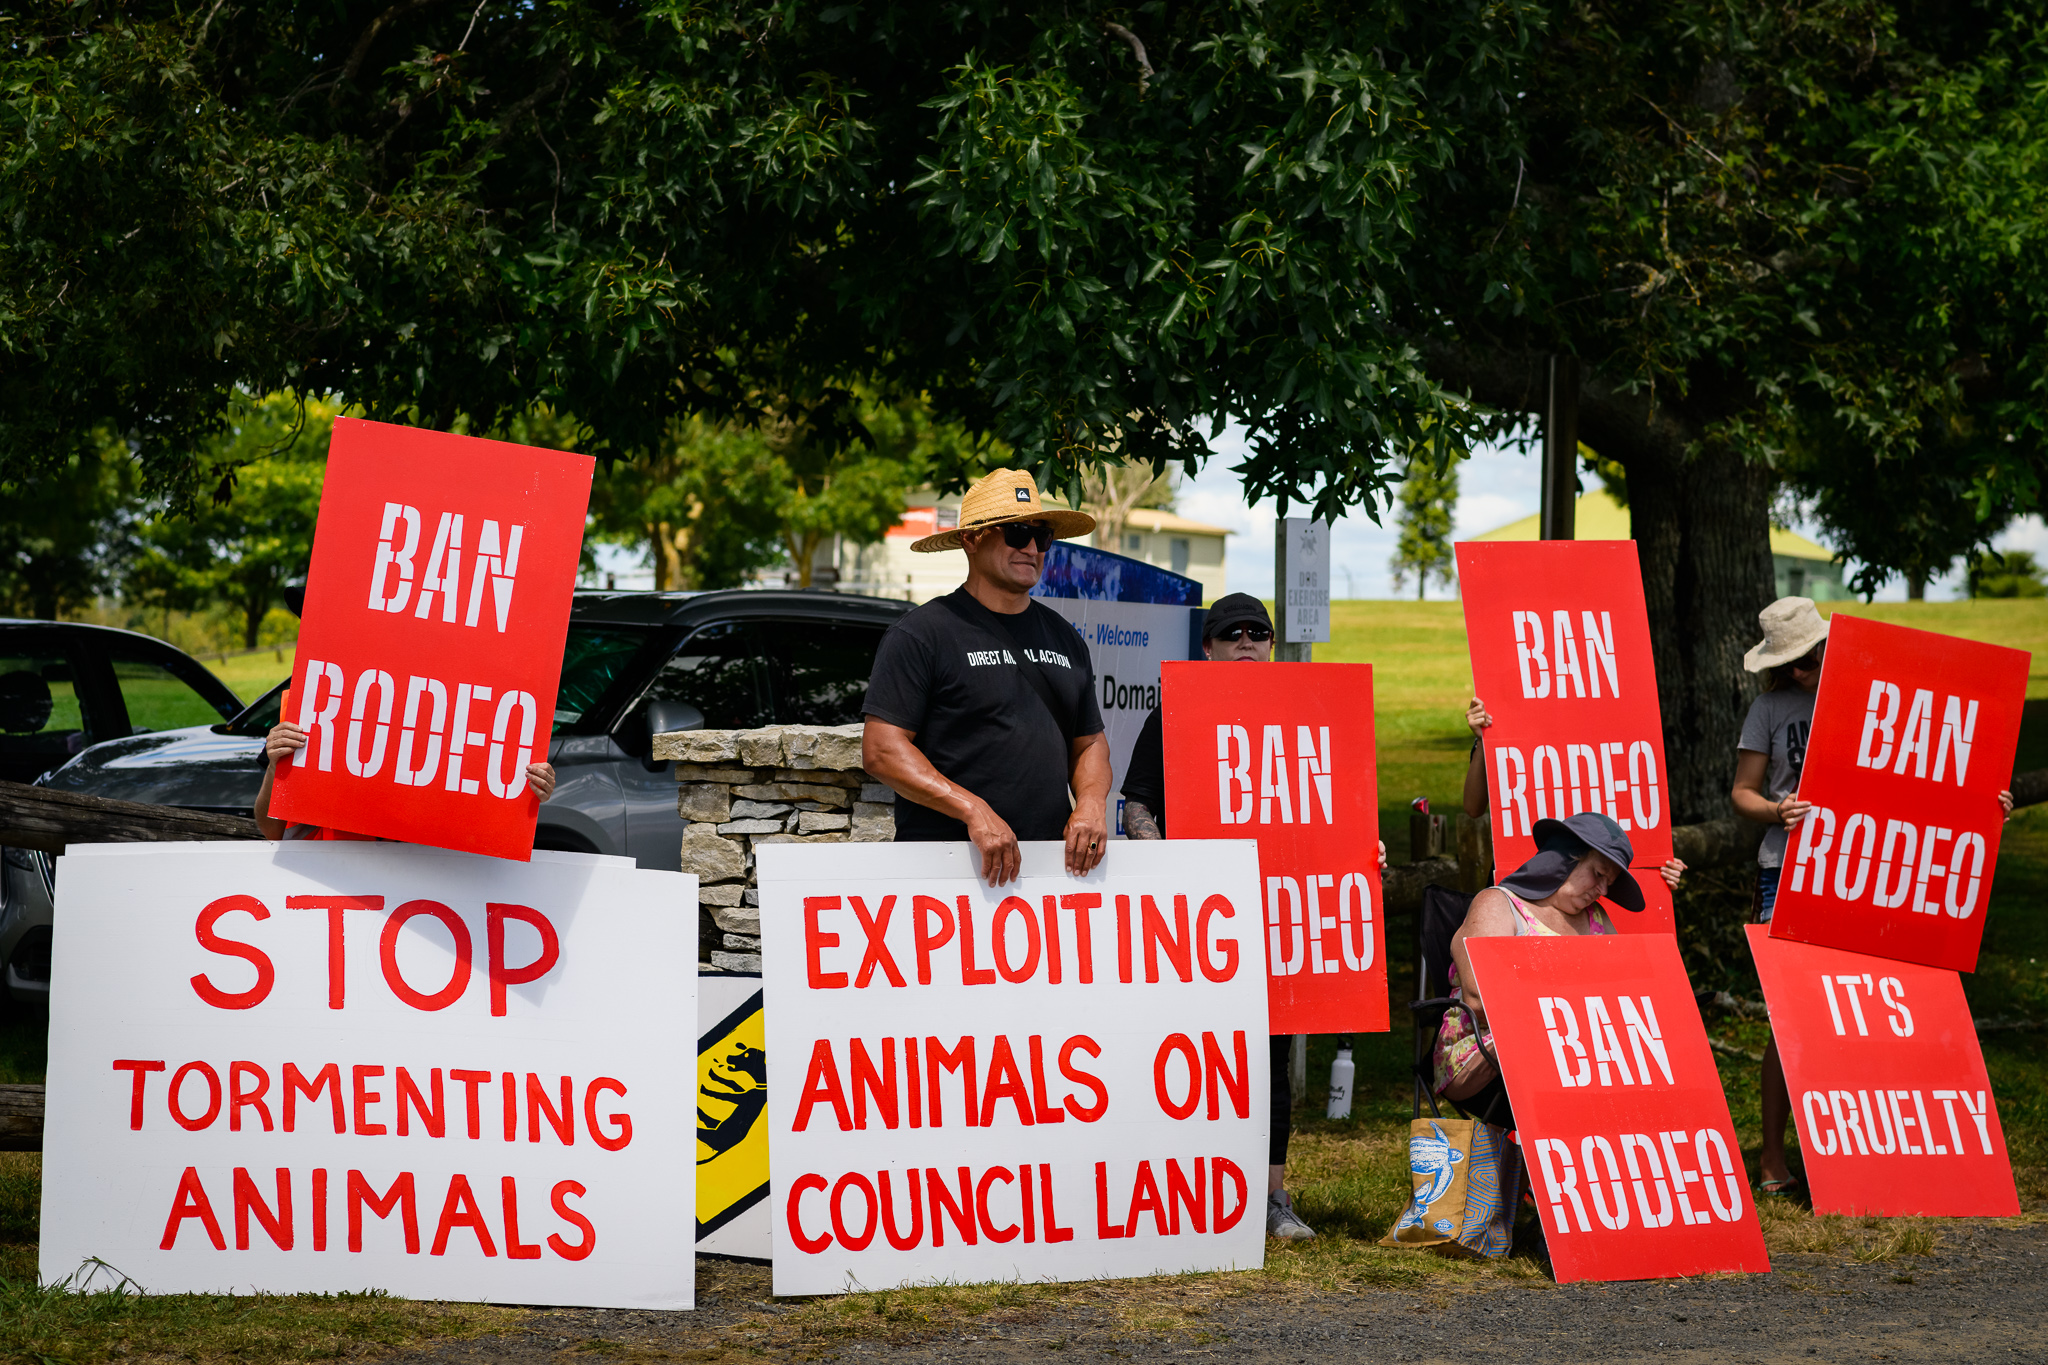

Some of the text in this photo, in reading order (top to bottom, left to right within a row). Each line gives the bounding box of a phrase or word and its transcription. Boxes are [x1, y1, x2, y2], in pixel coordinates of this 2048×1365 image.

[368, 502, 523, 632] BAN
[1288, 589, 1329, 605] EXERCISE
[1299, 571, 1317, 587] DOG
[967, 649, 1071, 669] DIRECT ANAL ACTION
[1097, 623, 1149, 647] Welcome
[1297, 608, 1319, 625] AREA
[1513, 610, 1619, 698] BAN
[292, 660, 536, 799] RODEO
[1103, 675, 1161, 710] Domai
[1857, 680, 1978, 786] BAN
[1217, 725, 1332, 824] BAN
[1494, 740, 1660, 837] RODEO
[1791, 805, 1984, 919] RODEO
[190, 895, 559, 1017] STOP
[803, 893, 1239, 989] EXPLOITING
[1267, 873, 1374, 976] DEO
[1538, 996, 1674, 1087] BAN
[1821, 974, 1914, 1037] IT'S
[113, 1060, 632, 1151] TORMENTING
[792, 1030, 1249, 1132] ANIMALS ON
[1803, 1090, 1993, 1158] CRUELTY
[160, 1167, 596, 1261] ANIMALS
[787, 1157, 1247, 1254] COUNCIL LAND
[1534, 1129, 1742, 1233] RODEO
